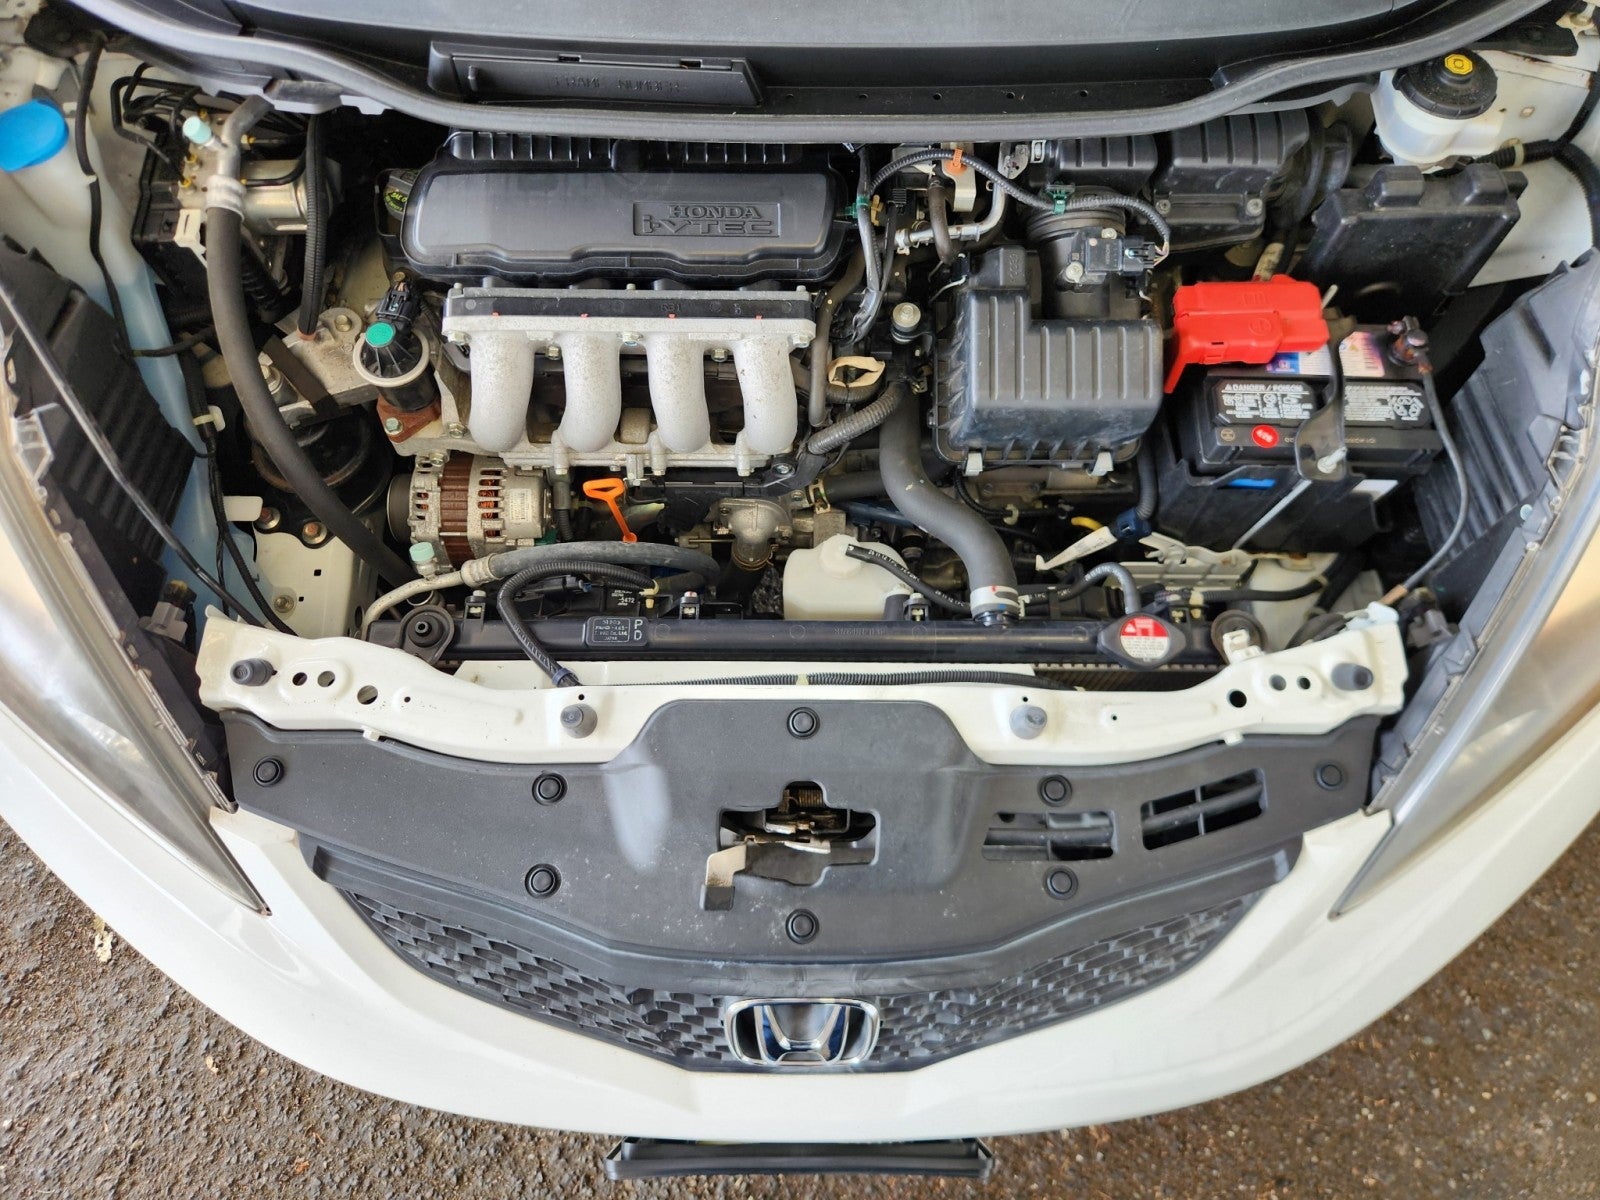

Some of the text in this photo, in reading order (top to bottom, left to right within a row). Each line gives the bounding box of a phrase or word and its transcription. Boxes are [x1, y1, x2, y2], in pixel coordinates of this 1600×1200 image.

[668, 205, 762, 219] HONDA
[642, 214, 773, 235] i-VTEC
[1232, 383, 1266, 392] DANGER
[1272, 384, 1304, 393] POISON
[634, 619, 643, 630] P
[633, 630, 643, 640] D
